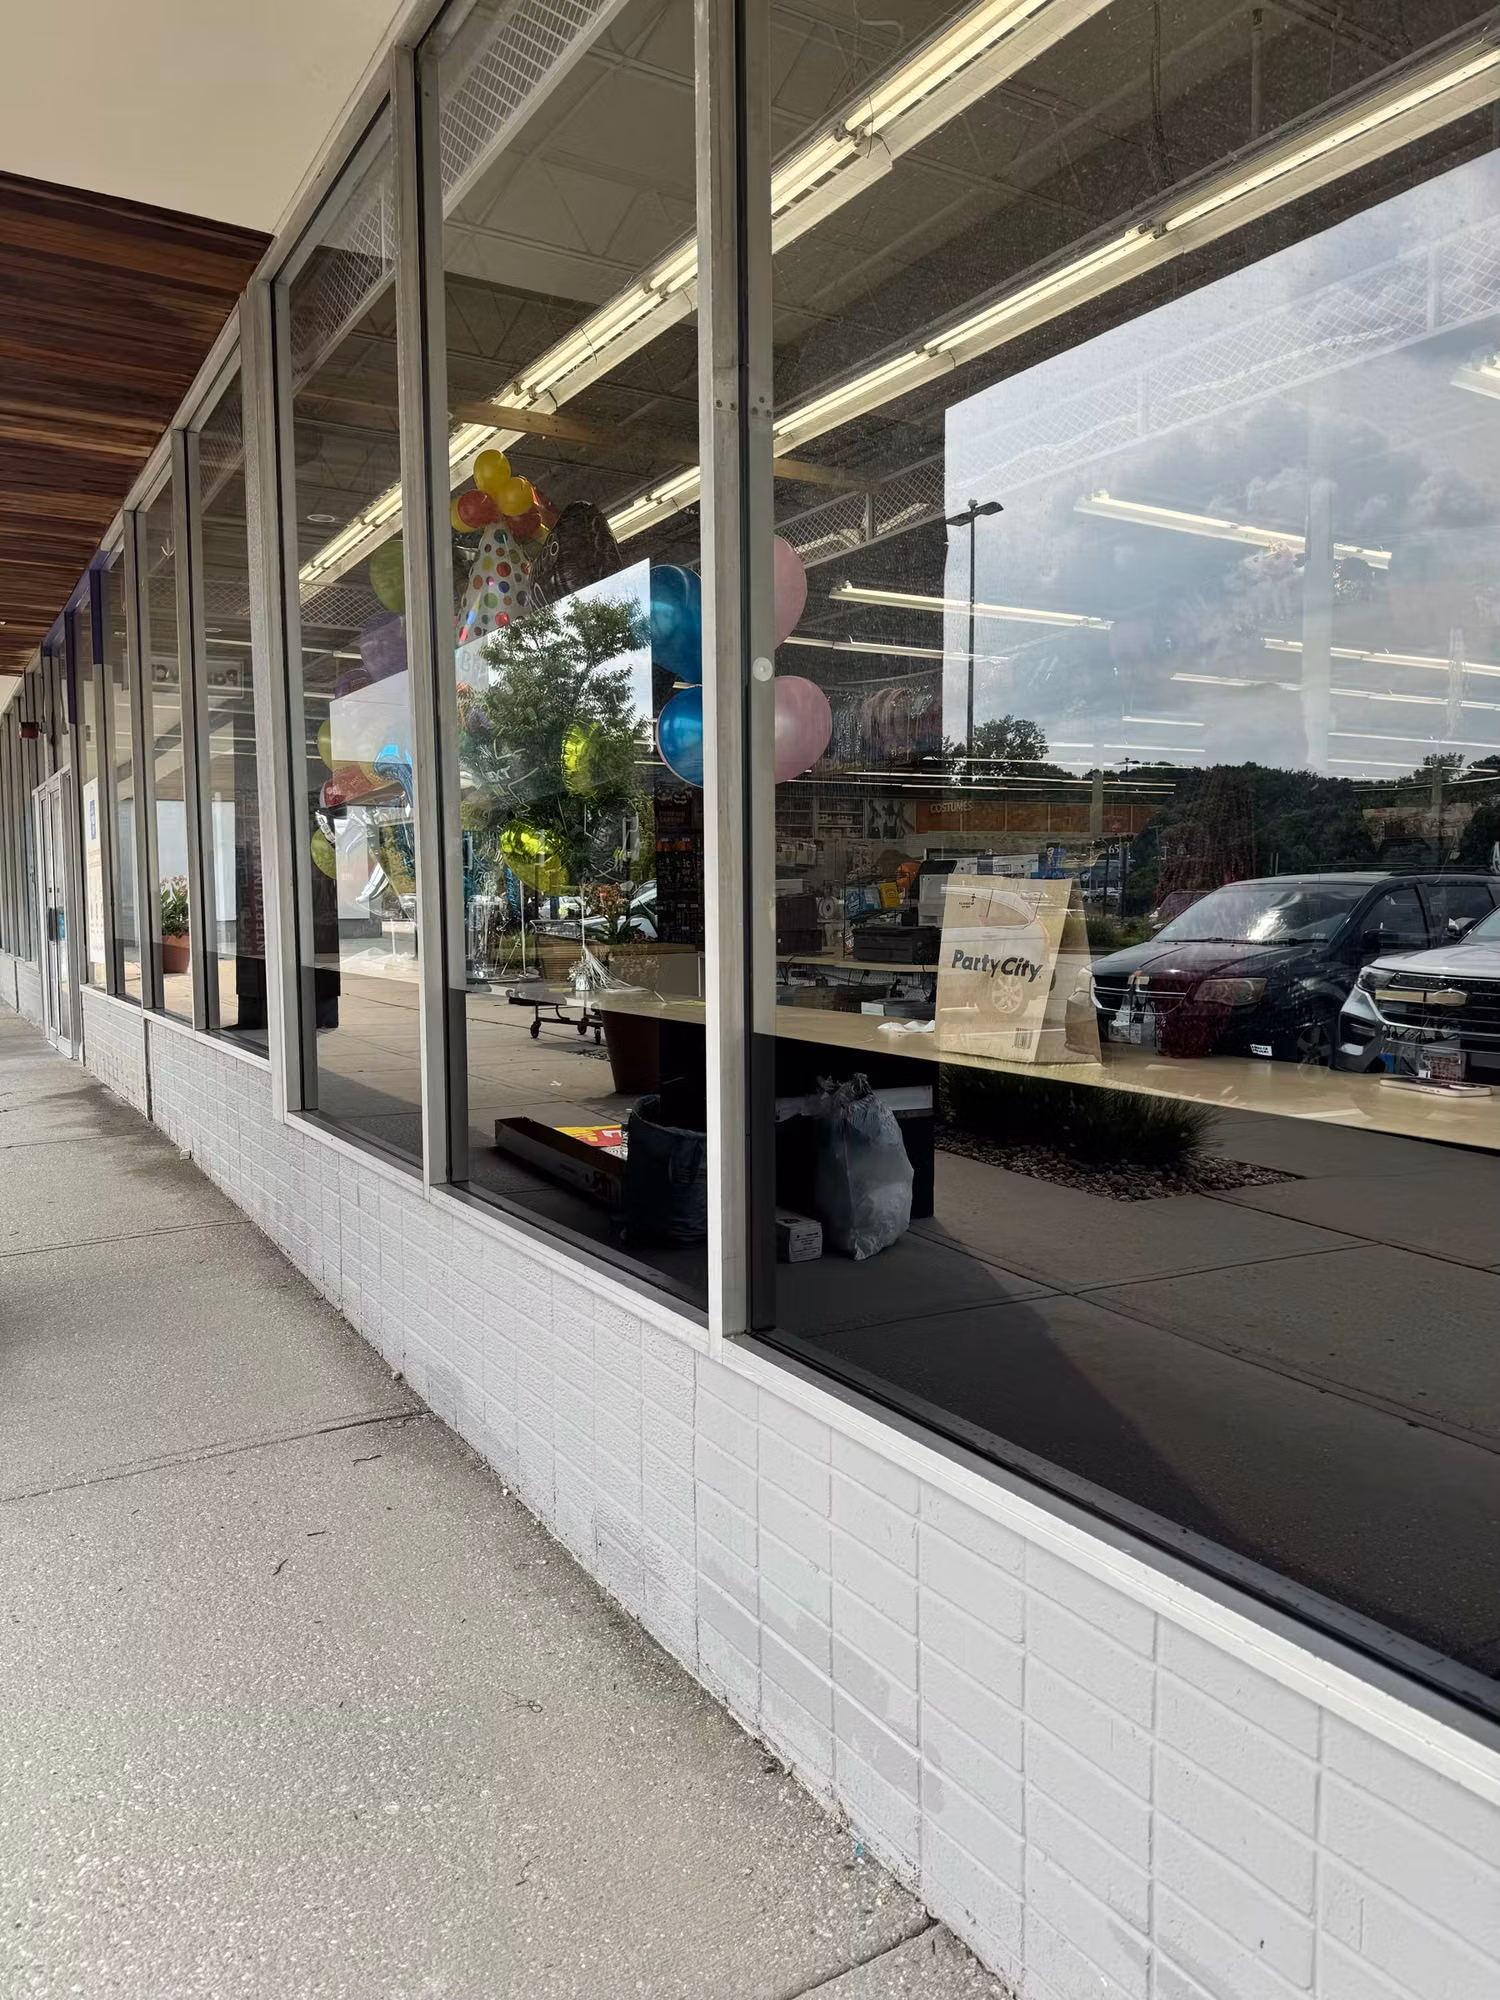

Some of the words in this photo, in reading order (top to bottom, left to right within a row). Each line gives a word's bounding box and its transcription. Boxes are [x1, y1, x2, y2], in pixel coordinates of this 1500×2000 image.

[930, 800, 974, 813] COSTUMES
[951, 949, 1001, 977] Party
[1000, 957, 1044, 982] City
